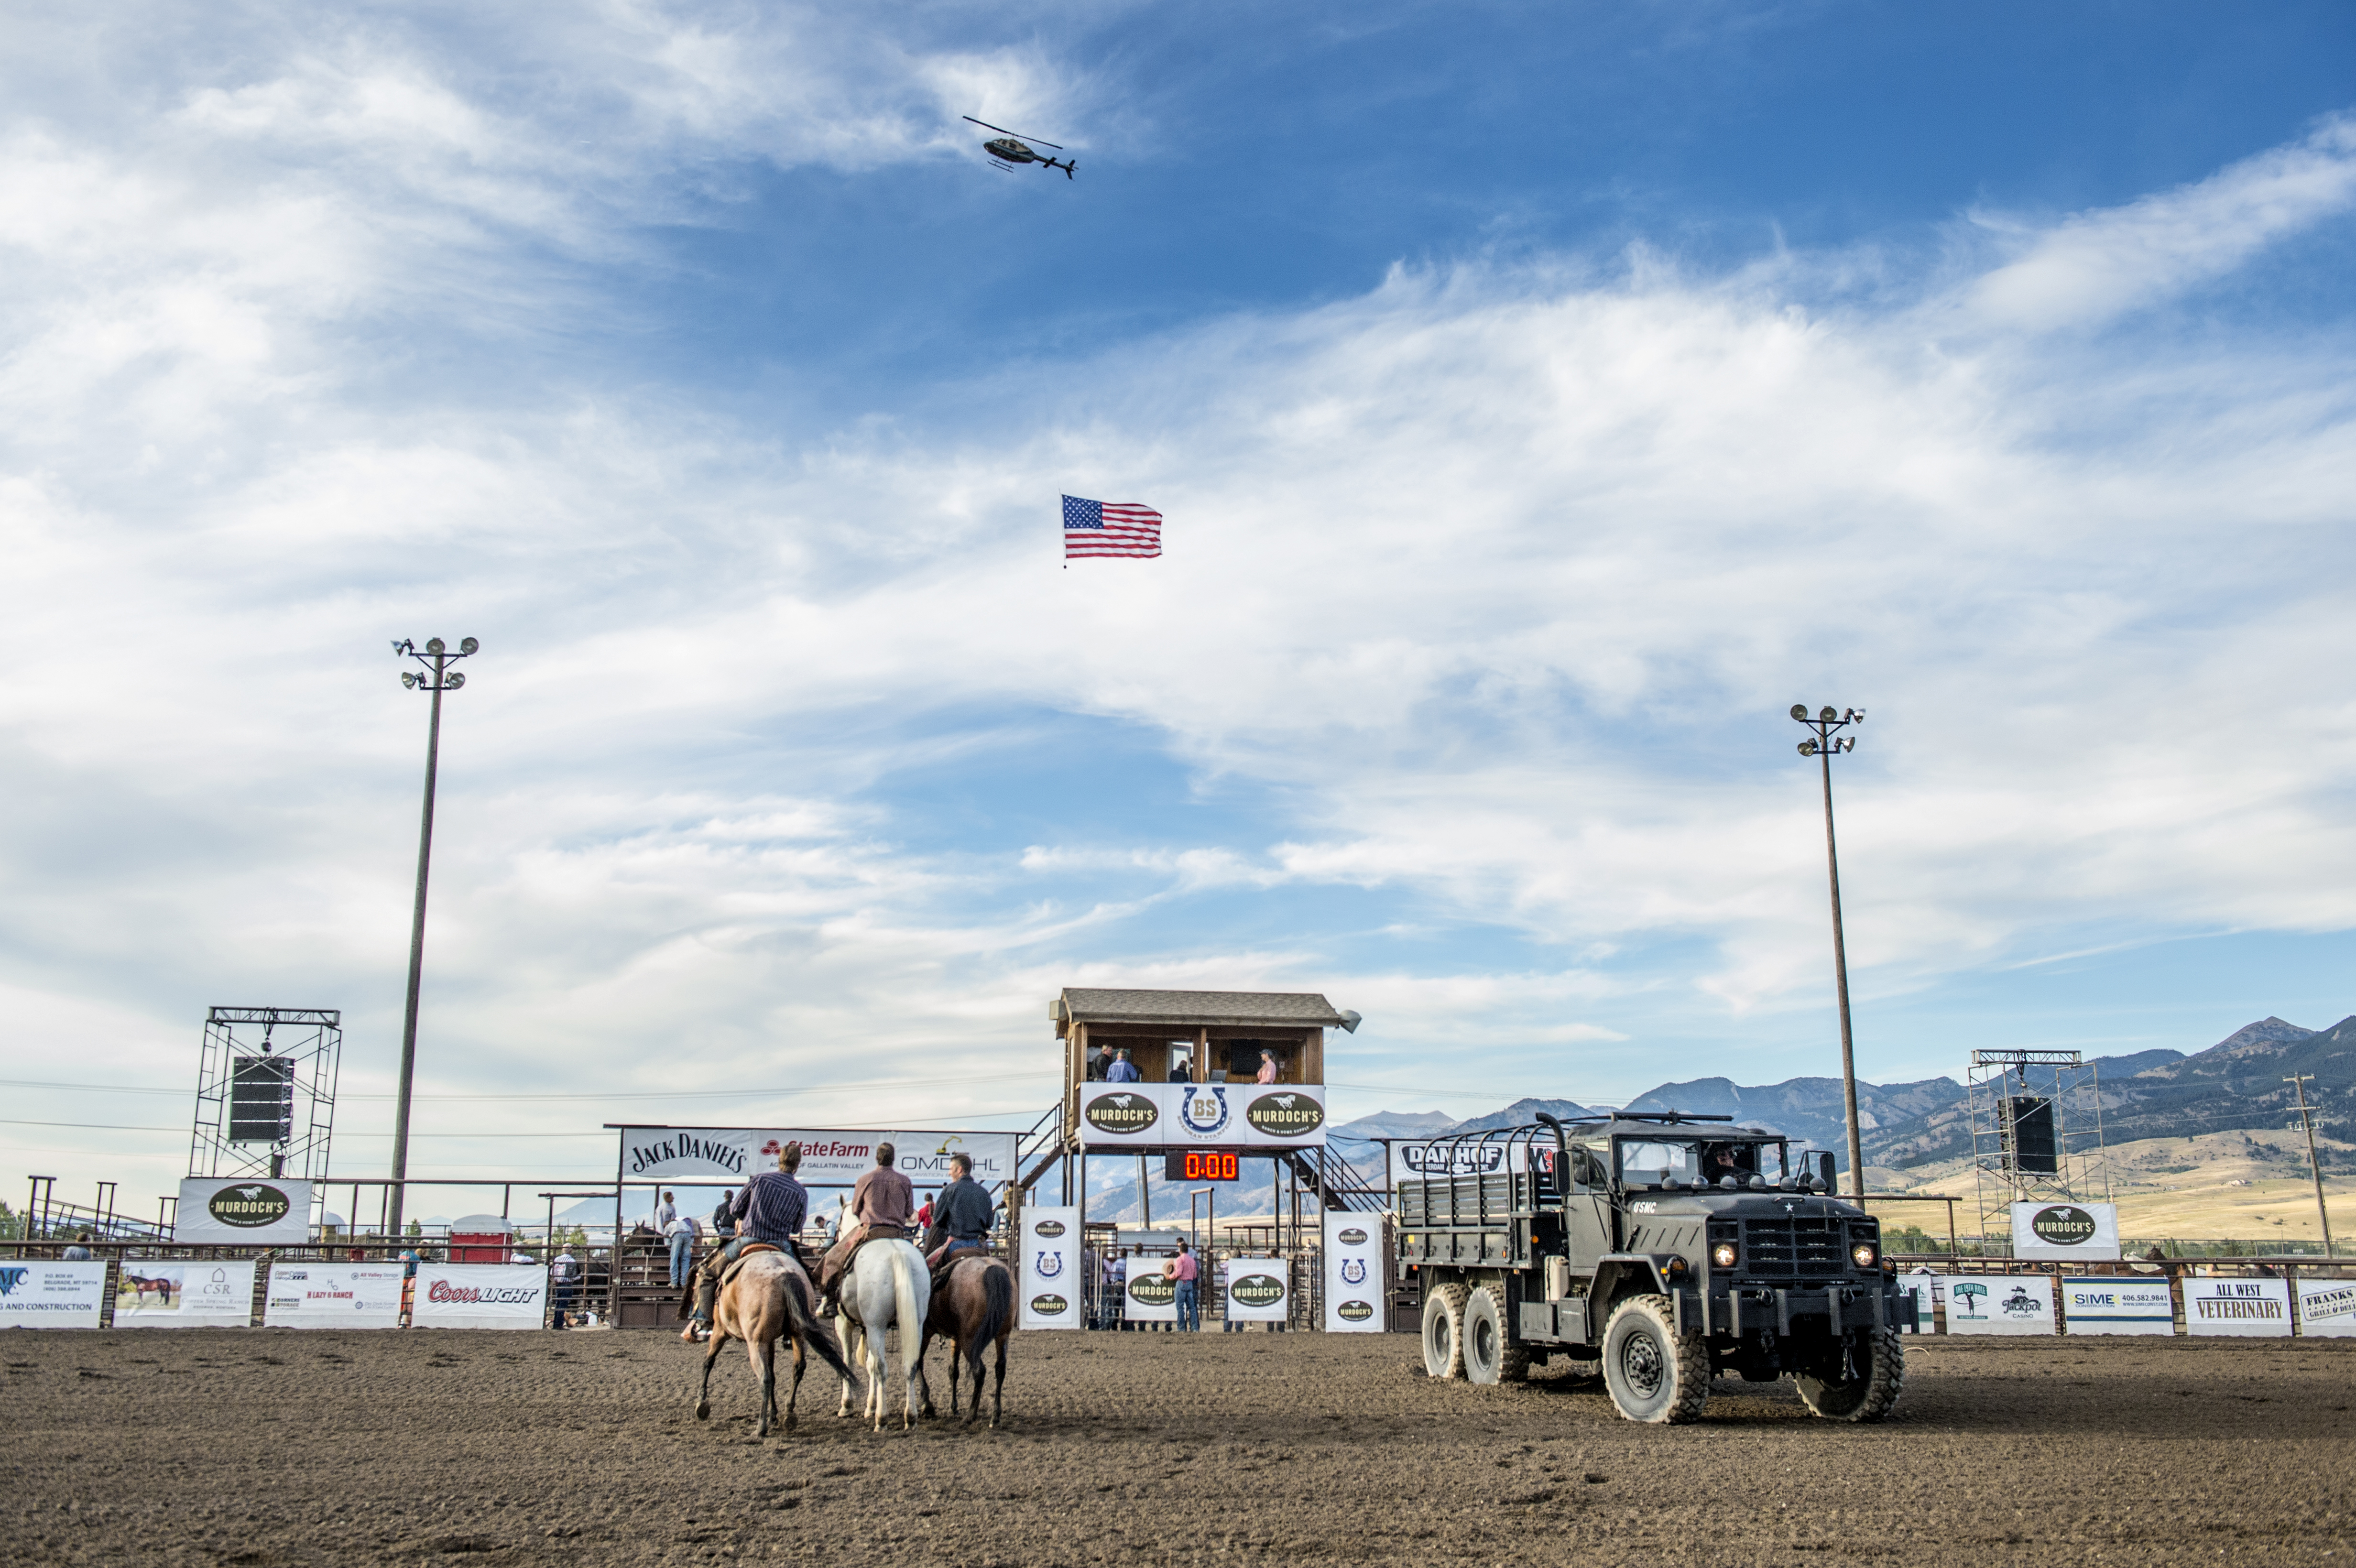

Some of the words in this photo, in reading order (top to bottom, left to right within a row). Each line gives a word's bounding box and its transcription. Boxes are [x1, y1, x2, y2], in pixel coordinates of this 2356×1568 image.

[1194, 1099, 1216, 1117] BS
[1091, 1109, 1153, 1121] MURDOCH'S
[1253, 1110, 1319, 1122] MURDOCH'S
[1177, 1115, 1202, 1139] BOZEMAN
[1204, 1115, 1233, 1139] STAMPEDE
[633, 1140, 676, 1173] JACK
[678, 1133, 747, 1173] DANIEL'S
[1409, 1147, 1498, 1163] DANHOF
[902, 1157, 1000, 1171] OMDHL
[1186, 1154, 1236, 1179] 0.00
[215, 1201, 284, 1213] MURDOCH'S
[1633, 1201, 1657, 1213] USMC
[2038, 1222, 2091, 1232] MURDOCH'S
[1043, 1259, 1056, 1269] BS
[1347, 1265, 1360, 1275] BS
[203, 1284, 231, 1295] CSR
[428, 1280, 480, 1303] Coors
[479, 1288, 539, 1303] LIGHT
[1132, 1286, 1175, 1296] MURDOCH'
[1234, 1287, 1281, 1297] MURDOCH'S
[1964, 1284, 1974, 1293] 19TH
[1974, 1285, 1985, 1294] HOLE
[2216, 1285, 2233, 1296] ALL
[2236, 1285, 2261, 1296] WEST
[2075, 1294, 2115, 1304] SIME
[2306, 1289, 2353, 1306] FRANKS
[2002, 1299, 2041, 1314] Jackpot
[2197, 1301, 2282, 1318] VETERINARY
[2310, 1309, 2332, 1318] GRILL
[2340, 1304, 2356, 1312] DELI
